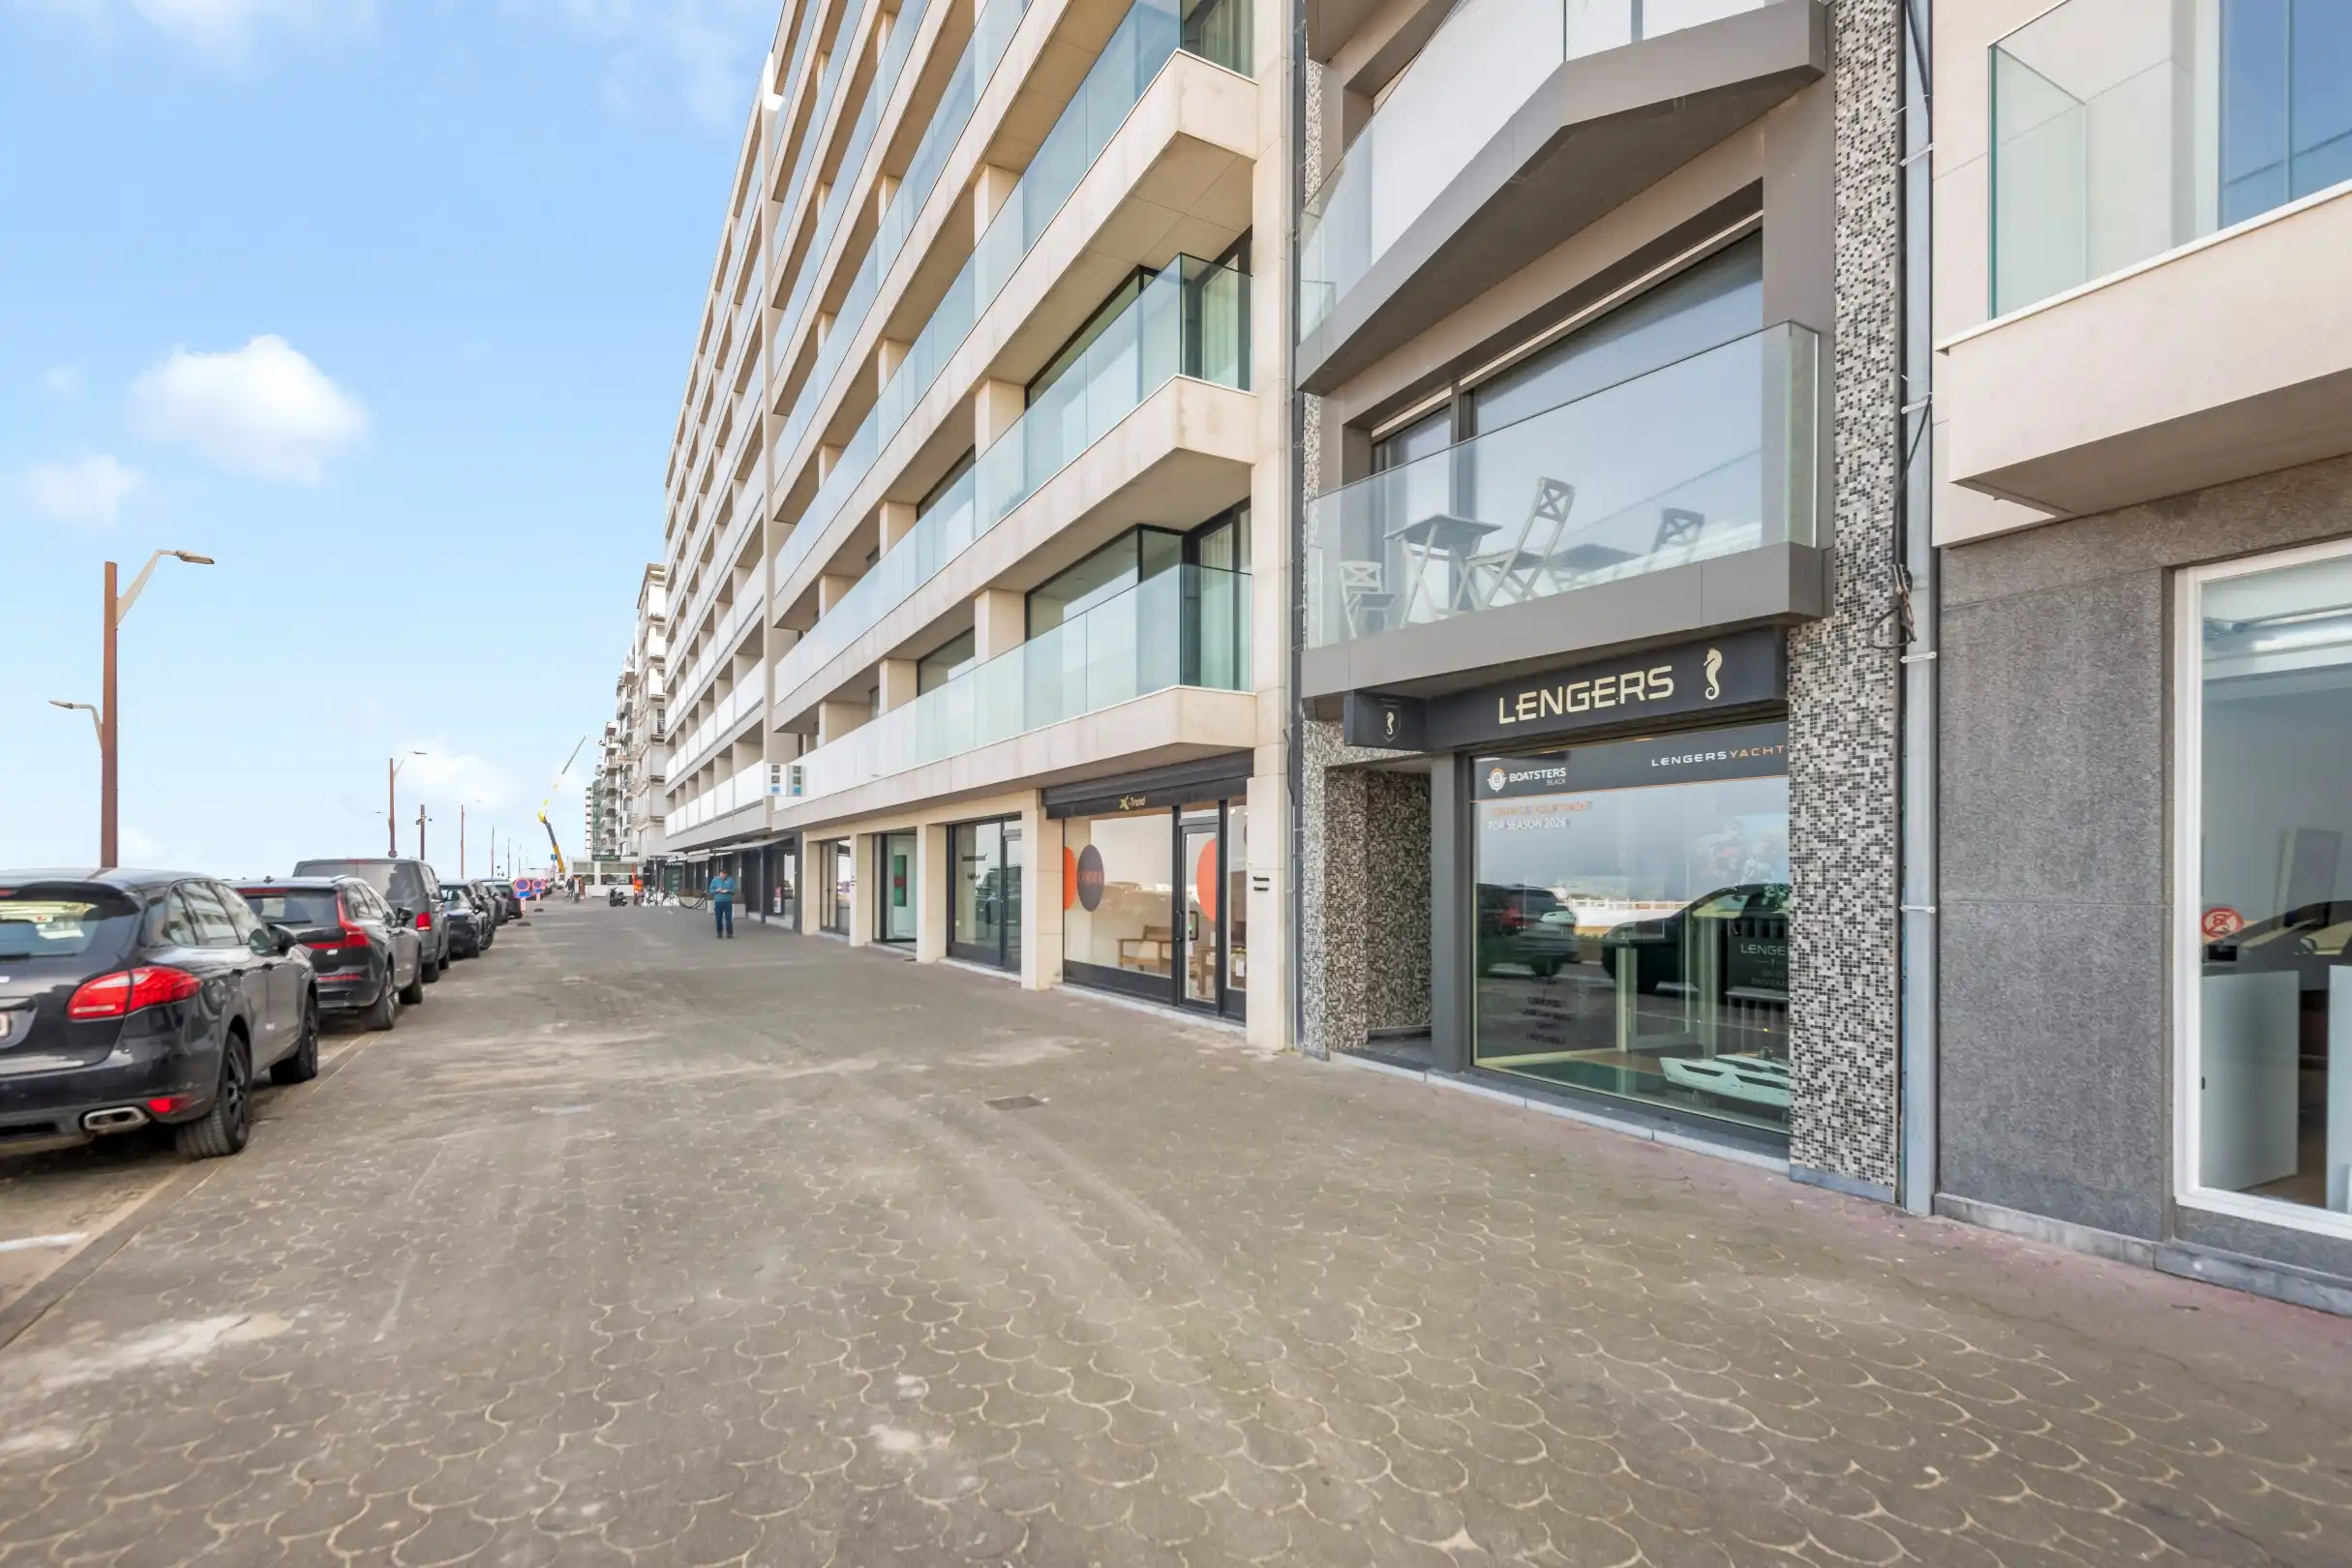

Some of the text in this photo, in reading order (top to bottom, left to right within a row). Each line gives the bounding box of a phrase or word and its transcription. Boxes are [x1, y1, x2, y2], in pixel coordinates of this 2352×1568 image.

[1498, 665, 1674, 725] LENGERS
[1509, 767, 1567, 783] BOATSTERS
[1488, 820, 1506, 830] FOR
[1507, 819, 1542, 830] SEASON
